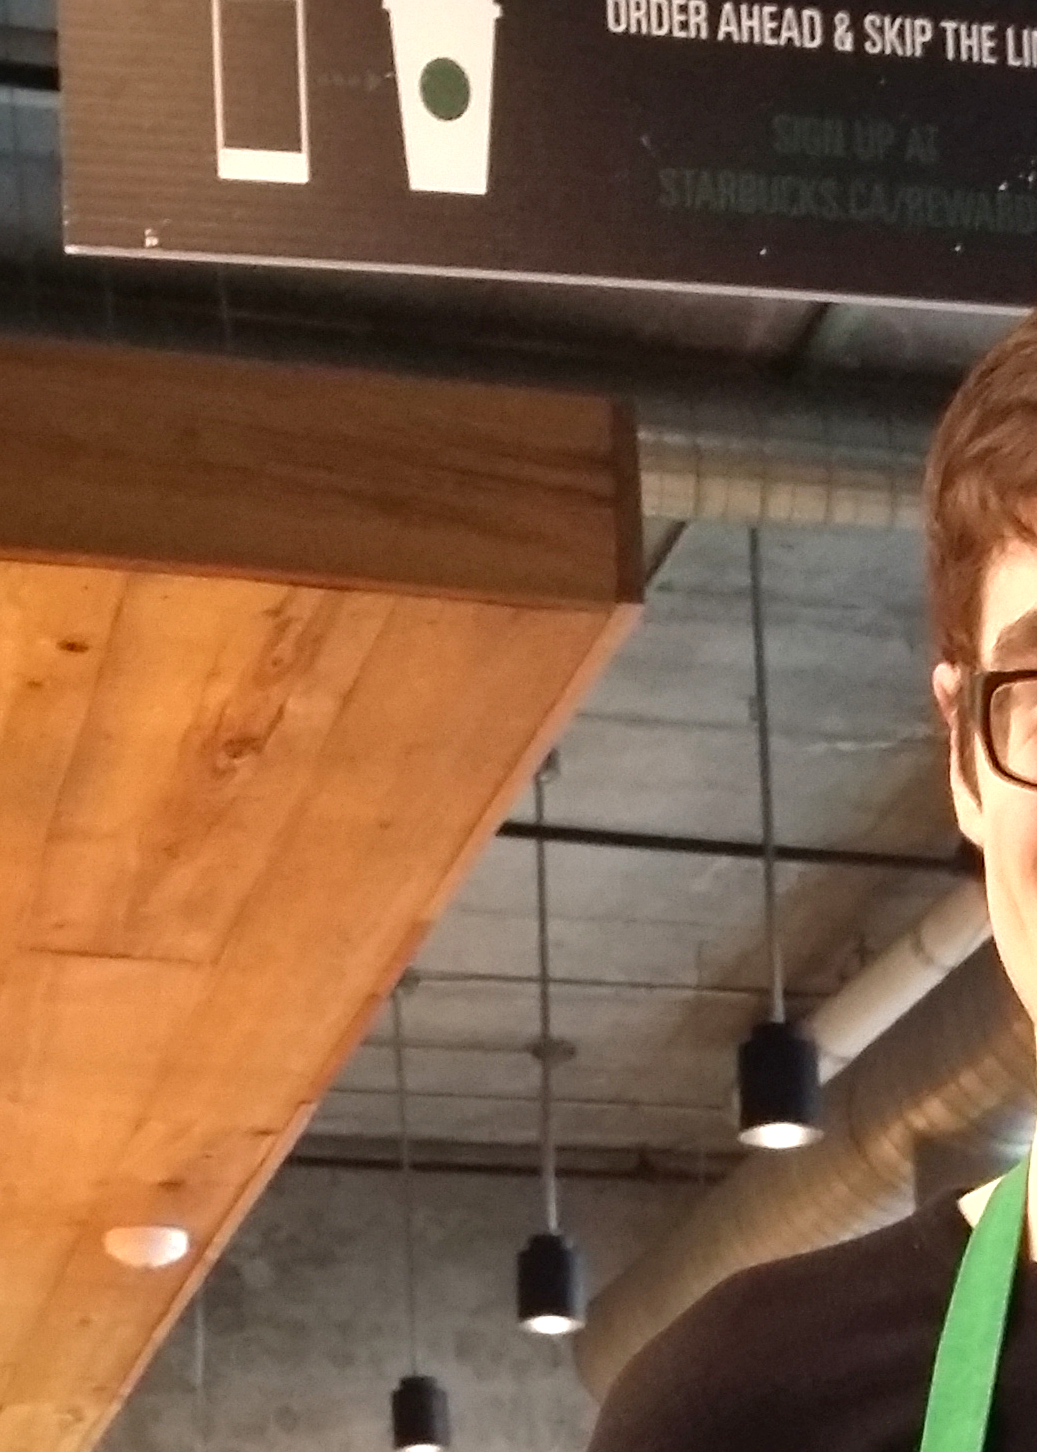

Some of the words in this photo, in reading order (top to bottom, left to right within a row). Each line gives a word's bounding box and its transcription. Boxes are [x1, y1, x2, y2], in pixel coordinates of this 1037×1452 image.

[606, 0, 708, 40] ORDER
[716, 2, 823, 48] AHEAD
[833, 11, 853, 52] &
[863, 12, 933, 58] SKIP
[939, 19, 998, 65] THE
[771, 112, 847, 158] SIGN
[852, 118, 896, 162] UP
[904, 123, 941, 165] AT
